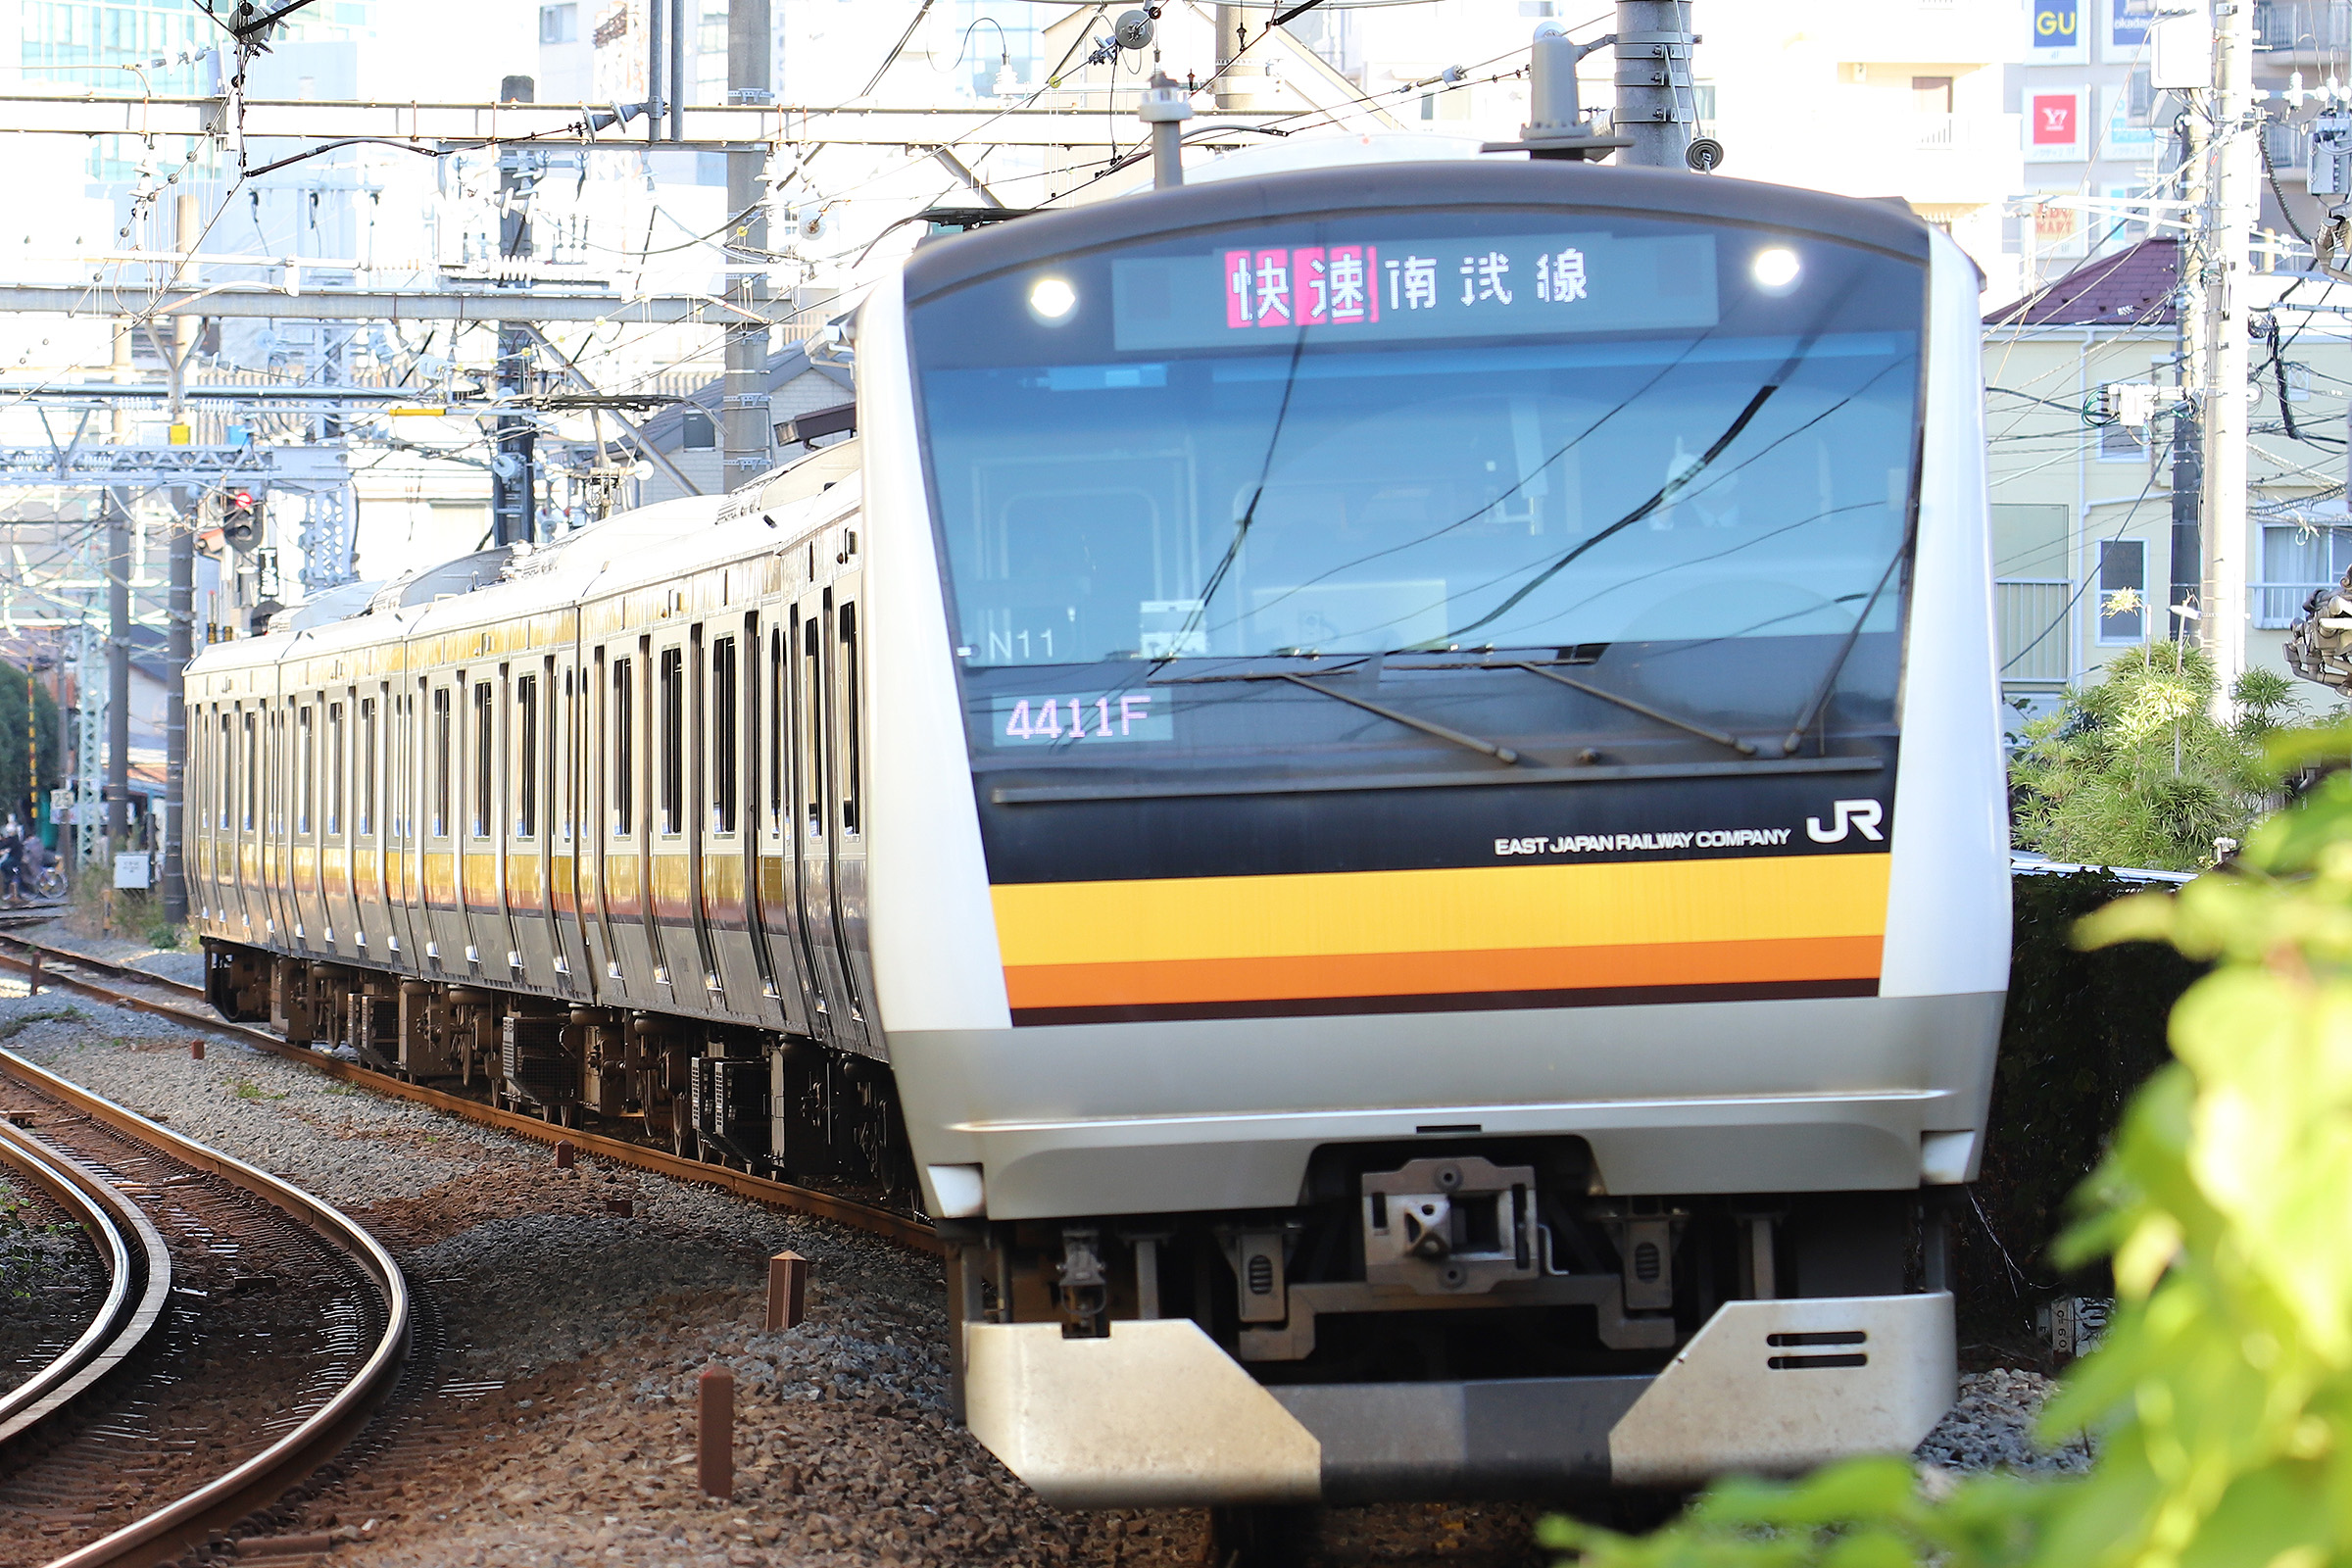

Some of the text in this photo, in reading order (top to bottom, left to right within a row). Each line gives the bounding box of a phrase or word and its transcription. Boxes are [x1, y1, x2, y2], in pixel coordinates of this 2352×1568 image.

[2036, 11, 2076, 35] GU
[988, 628, 1054, 661] N11
[1004, 695, 1152, 740] 4411F
[1805, 798, 1885, 844] JR
[1494, 828, 1792, 857] EAST JAPAN RAILWAY COMPANY
